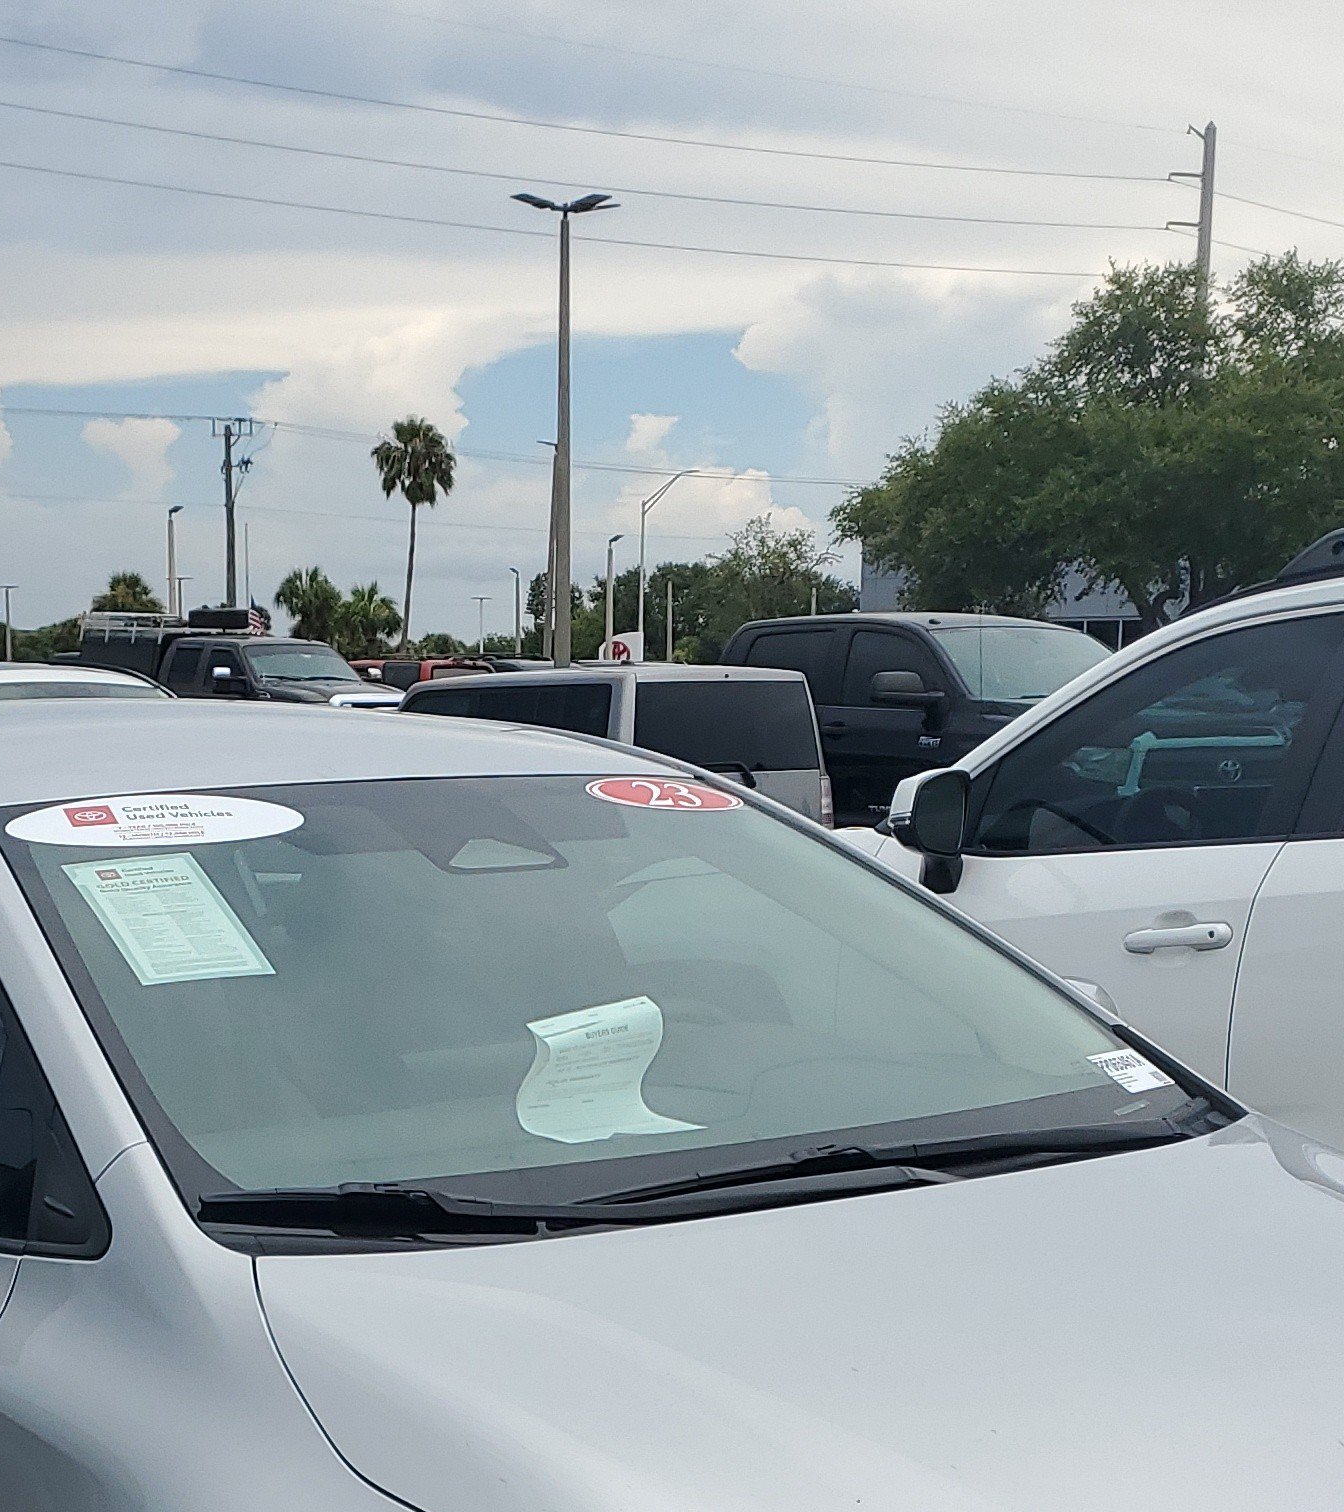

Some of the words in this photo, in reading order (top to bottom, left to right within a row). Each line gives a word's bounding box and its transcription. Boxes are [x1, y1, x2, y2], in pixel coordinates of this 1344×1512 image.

[630, 780, 703, 808] 23
[121, 803, 190, 813] Certified
[125, 812, 166, 821] Used
[168, 810, 234, 819] Vehicles
